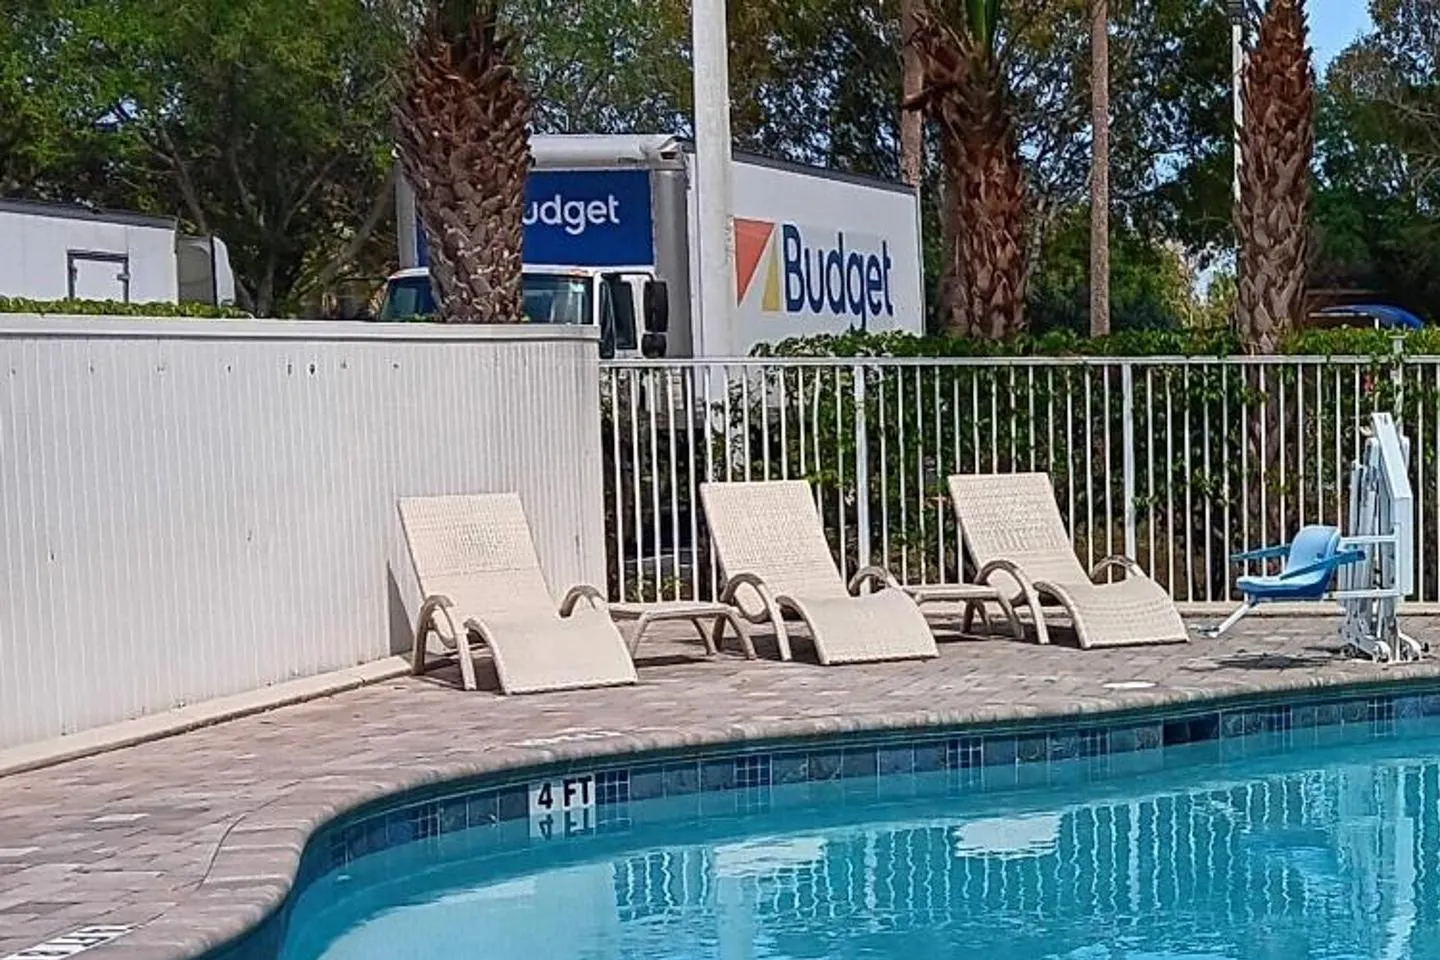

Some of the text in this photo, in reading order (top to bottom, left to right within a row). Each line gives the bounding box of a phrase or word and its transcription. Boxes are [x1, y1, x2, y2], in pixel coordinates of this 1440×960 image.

[522, 193, 620, 235] udget
[782, 223, 893, 331] Budget
[537, 776, 592, 810] 4 FT
